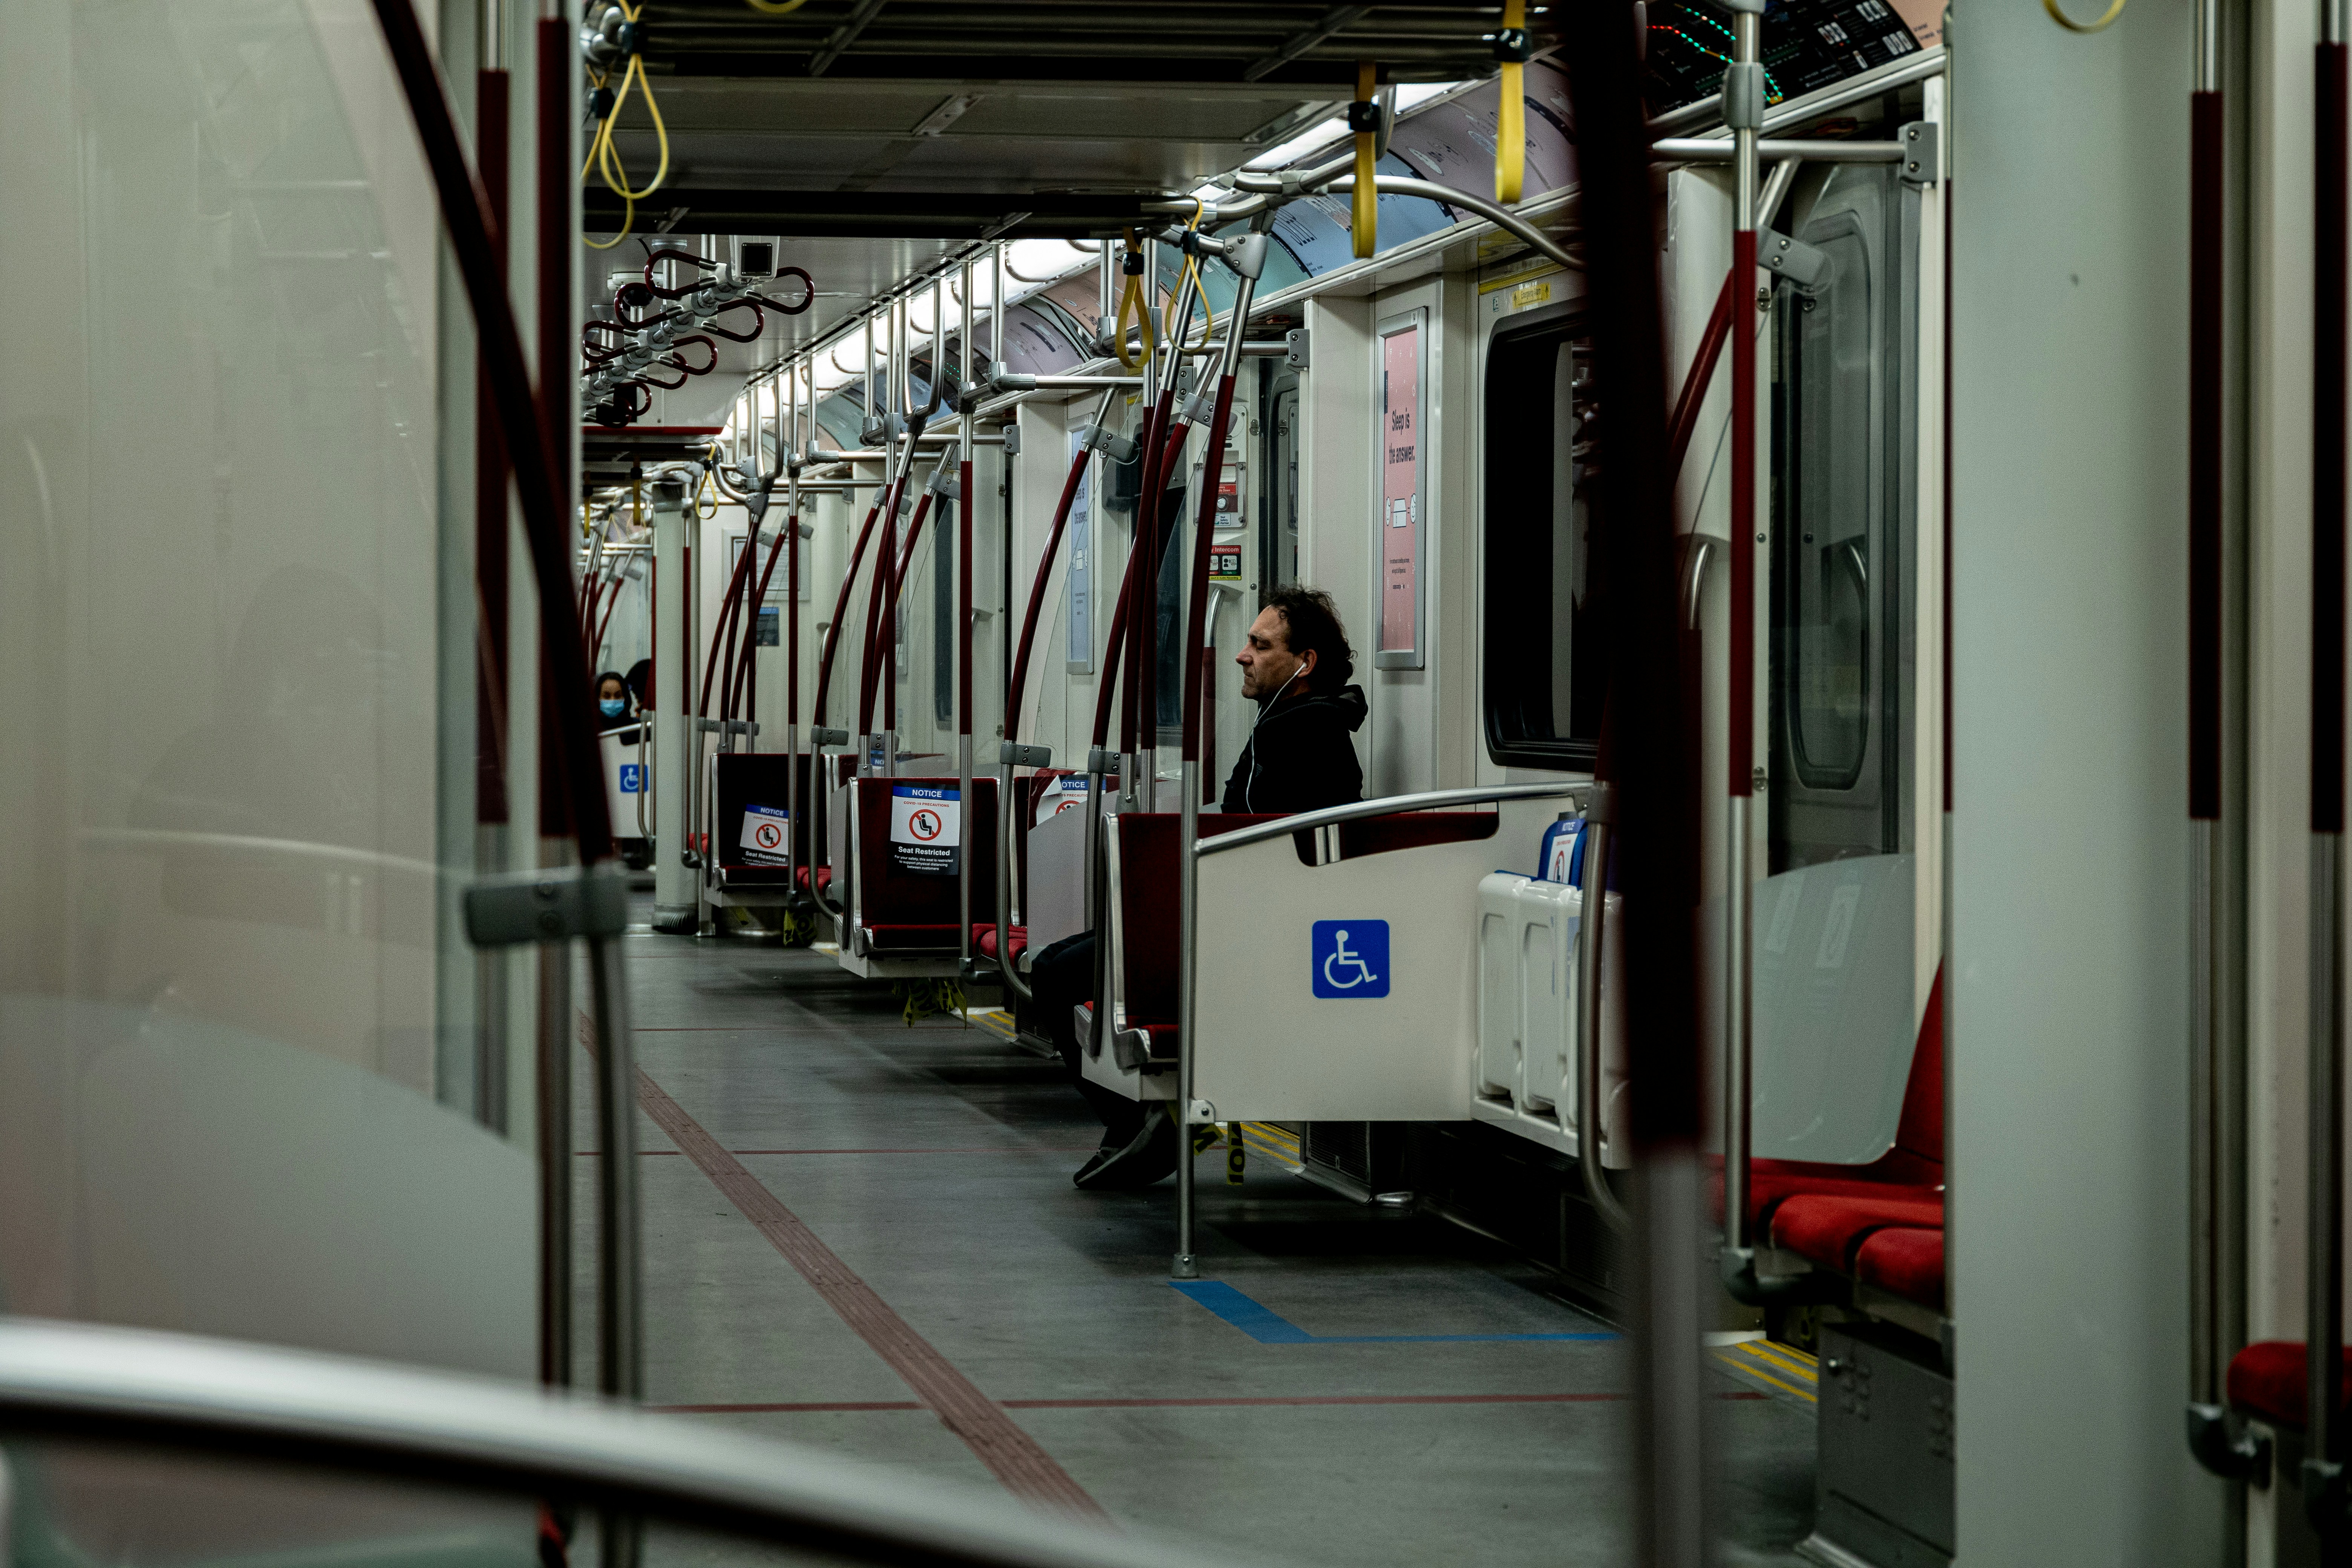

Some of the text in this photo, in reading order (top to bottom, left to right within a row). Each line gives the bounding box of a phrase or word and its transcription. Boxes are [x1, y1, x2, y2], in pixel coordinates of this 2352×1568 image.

[1392, 407, 1409, 435] Sleep is
[1396, 446, 1415, 463] answer.
[912, 789, 942, 798] NOTICE
[760, 807, 784, 816] NOTICE
[758, 853, 786, 862] Restricted
